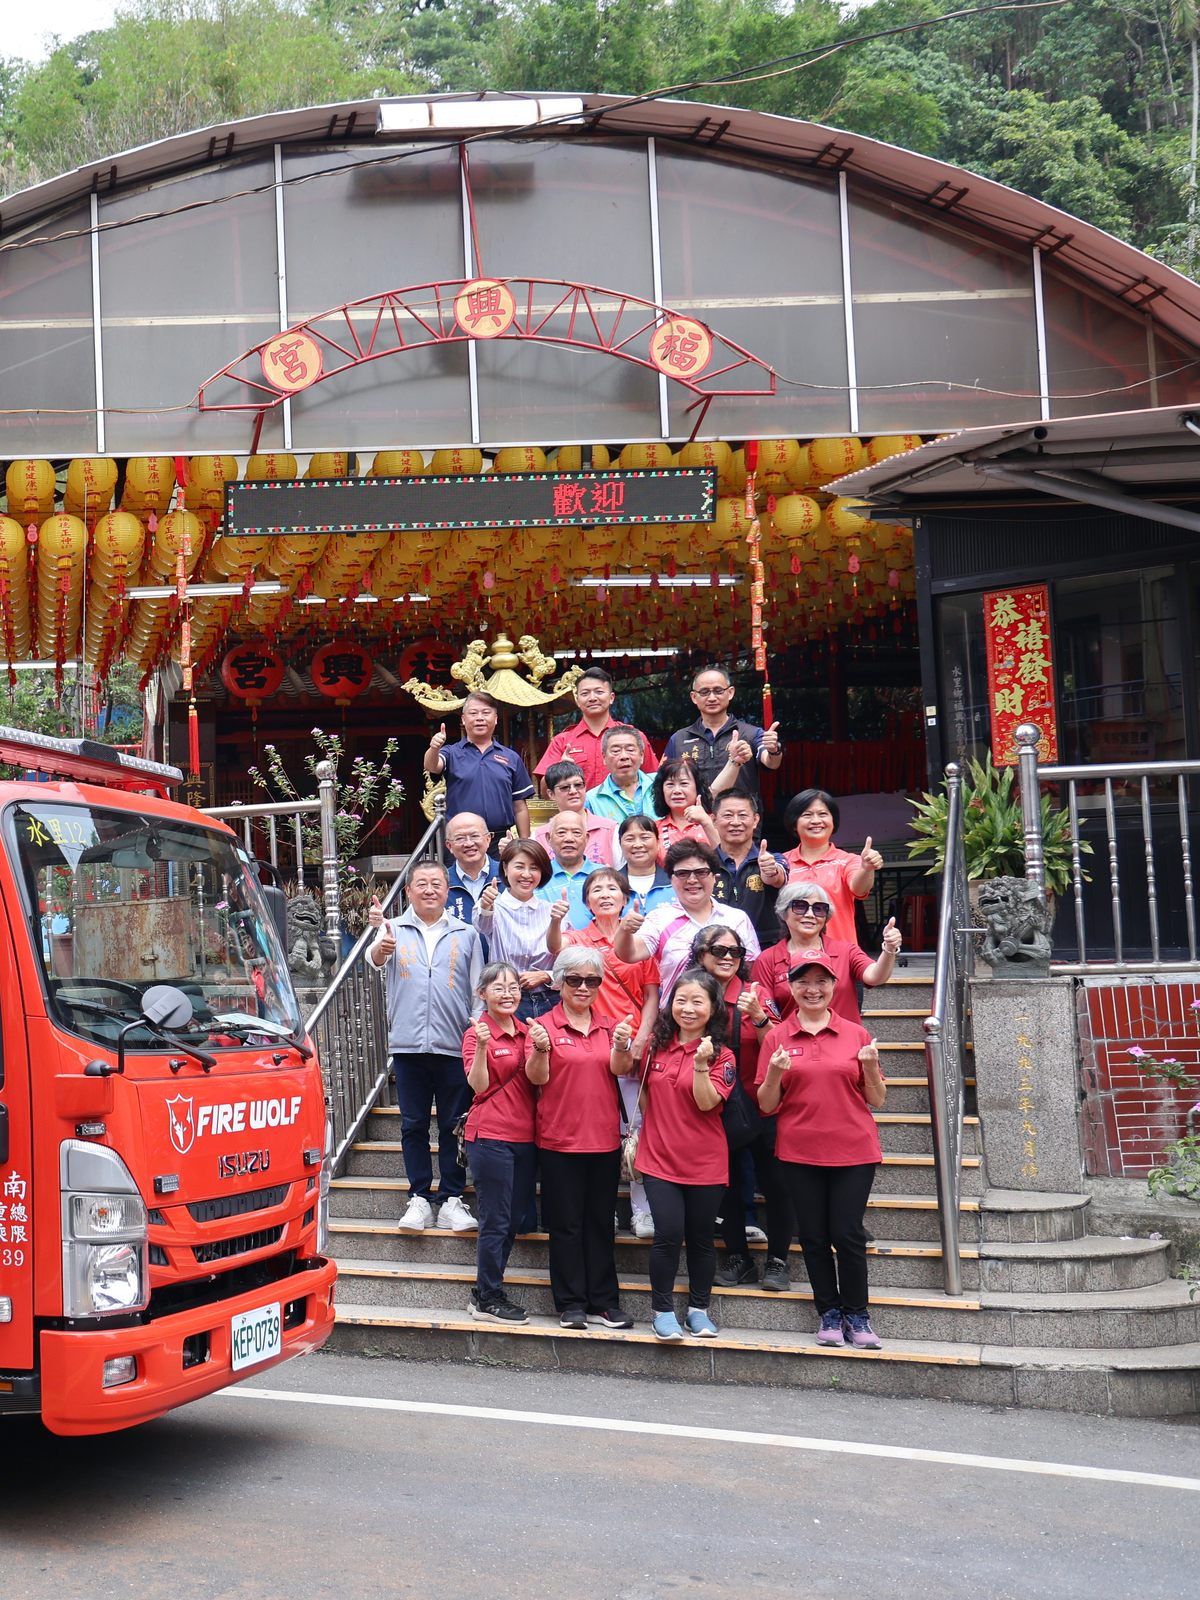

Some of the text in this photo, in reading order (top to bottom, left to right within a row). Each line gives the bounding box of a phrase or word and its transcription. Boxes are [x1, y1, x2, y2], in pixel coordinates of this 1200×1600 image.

[553, 482, 625, 516] 歡迎
[197, 1096, 302, 1137] FIRE WOLF
[218, 1148, 270, 1180] ISUZU
[233, 1316, 280, 1362] KEP-0739
